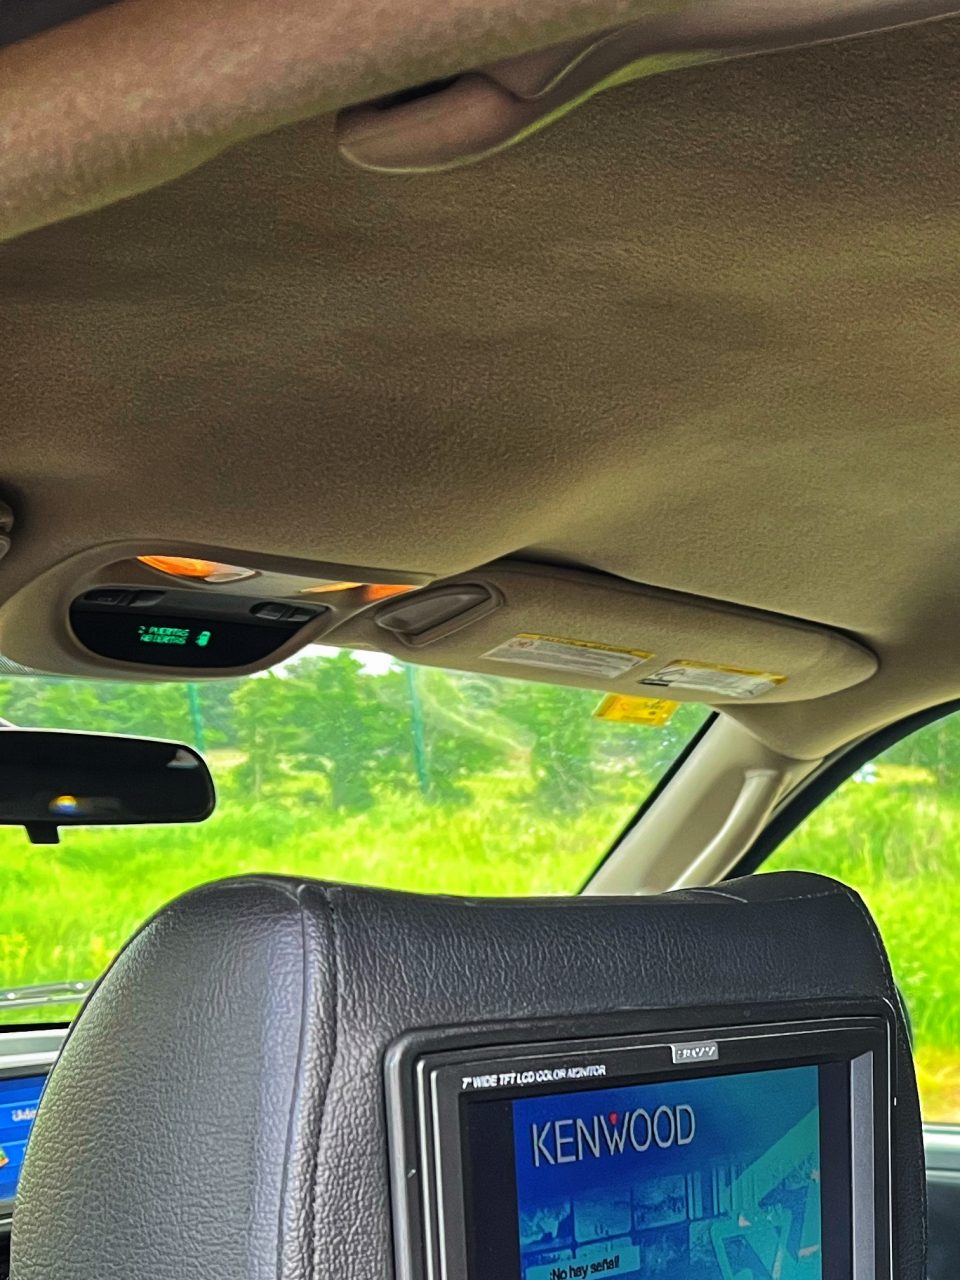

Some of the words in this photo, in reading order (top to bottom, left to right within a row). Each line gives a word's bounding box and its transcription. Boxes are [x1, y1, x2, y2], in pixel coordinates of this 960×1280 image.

[472, 1074, 498, 1089] WIDE
[499, 1072, 516, 1086] TFT
[516, 1070, 535, 1084] LCD
[535, 1068, 566, 1083] COLOR
[566, 1065, 607, 1079] MONITOR
[531, 1104, 696, 1168] KENWOOD
[568, 1262, 588, 1280] hay
